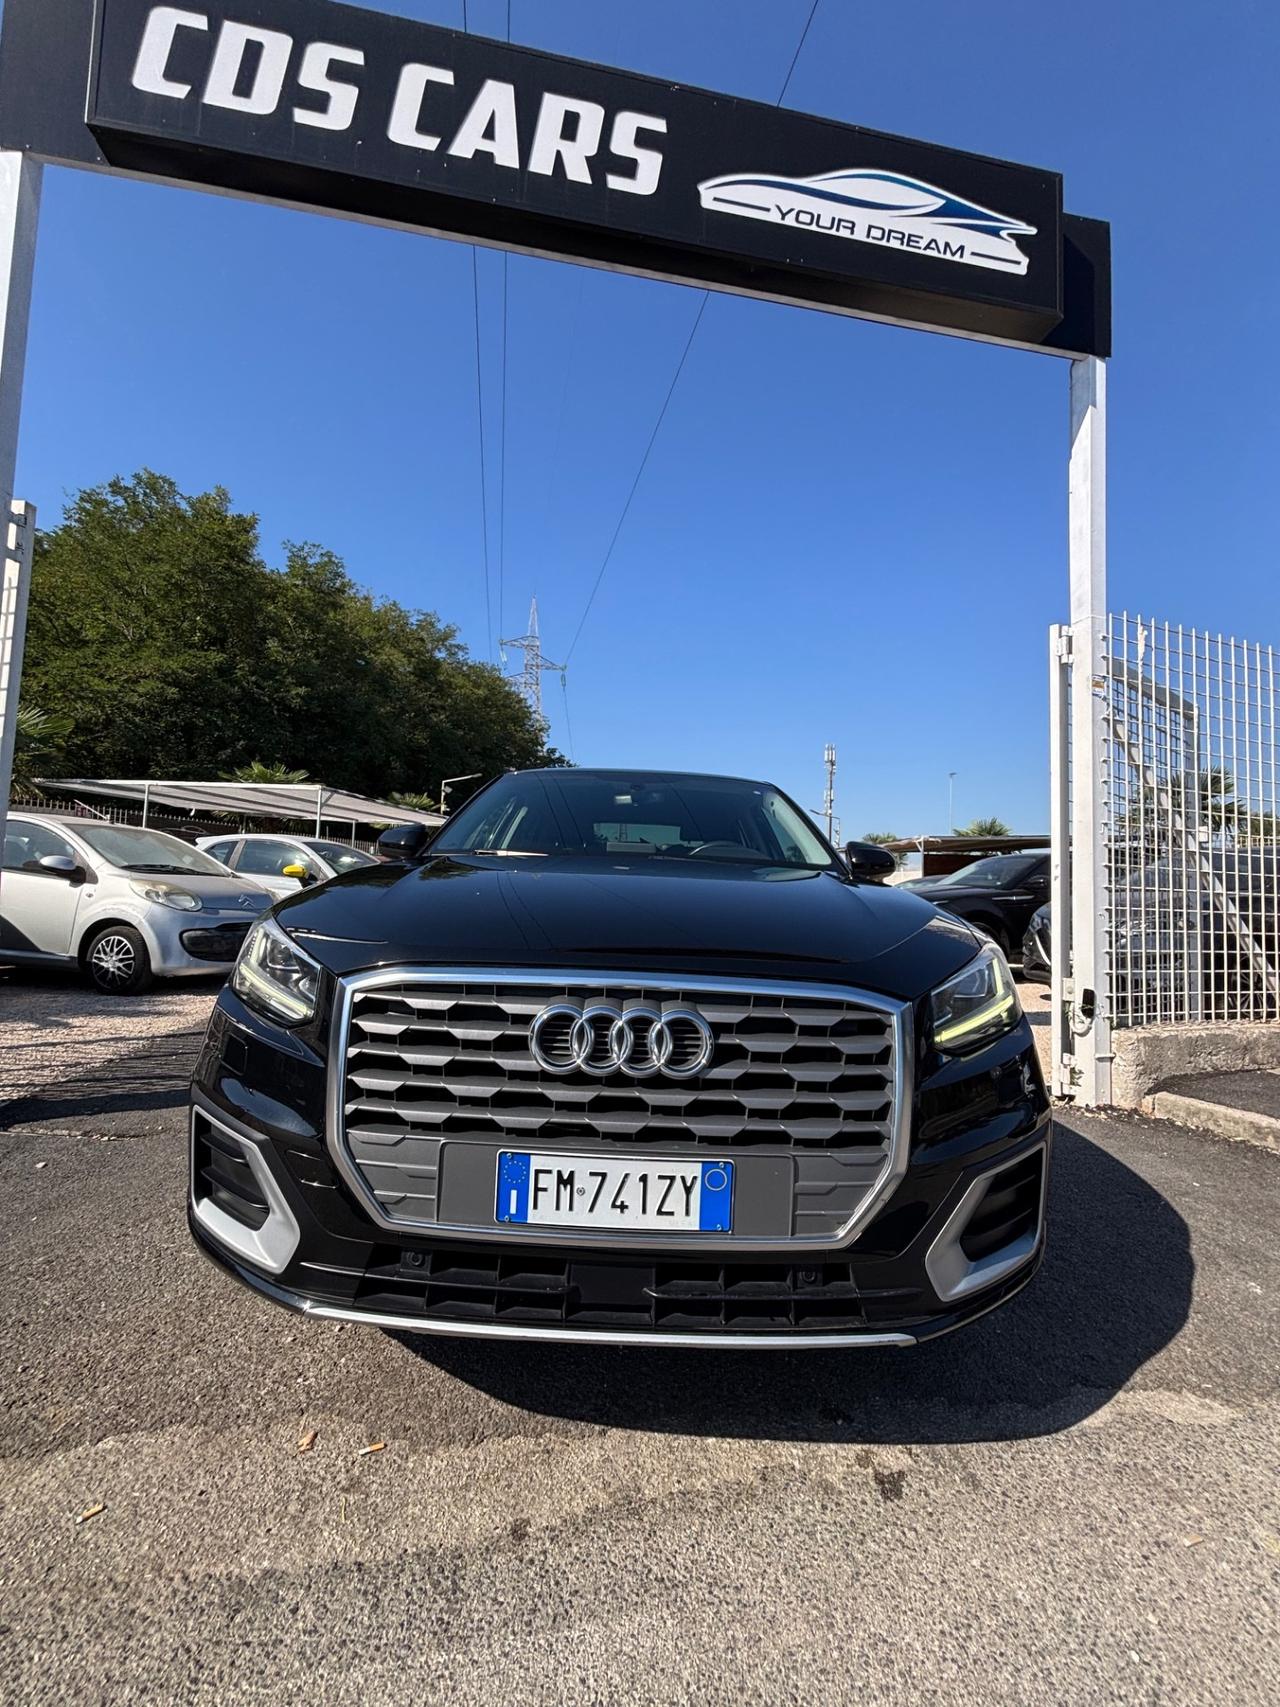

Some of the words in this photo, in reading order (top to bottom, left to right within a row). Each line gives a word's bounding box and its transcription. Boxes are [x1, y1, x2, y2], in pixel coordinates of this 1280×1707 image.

[131, 6, 366, 131] CDS
[387, 63, 668, 196] CARS
[775, 204, 856, 236] YOUR
[866, 224, 966, 260] DREAM
[510, 1190, 517, 1214] I
